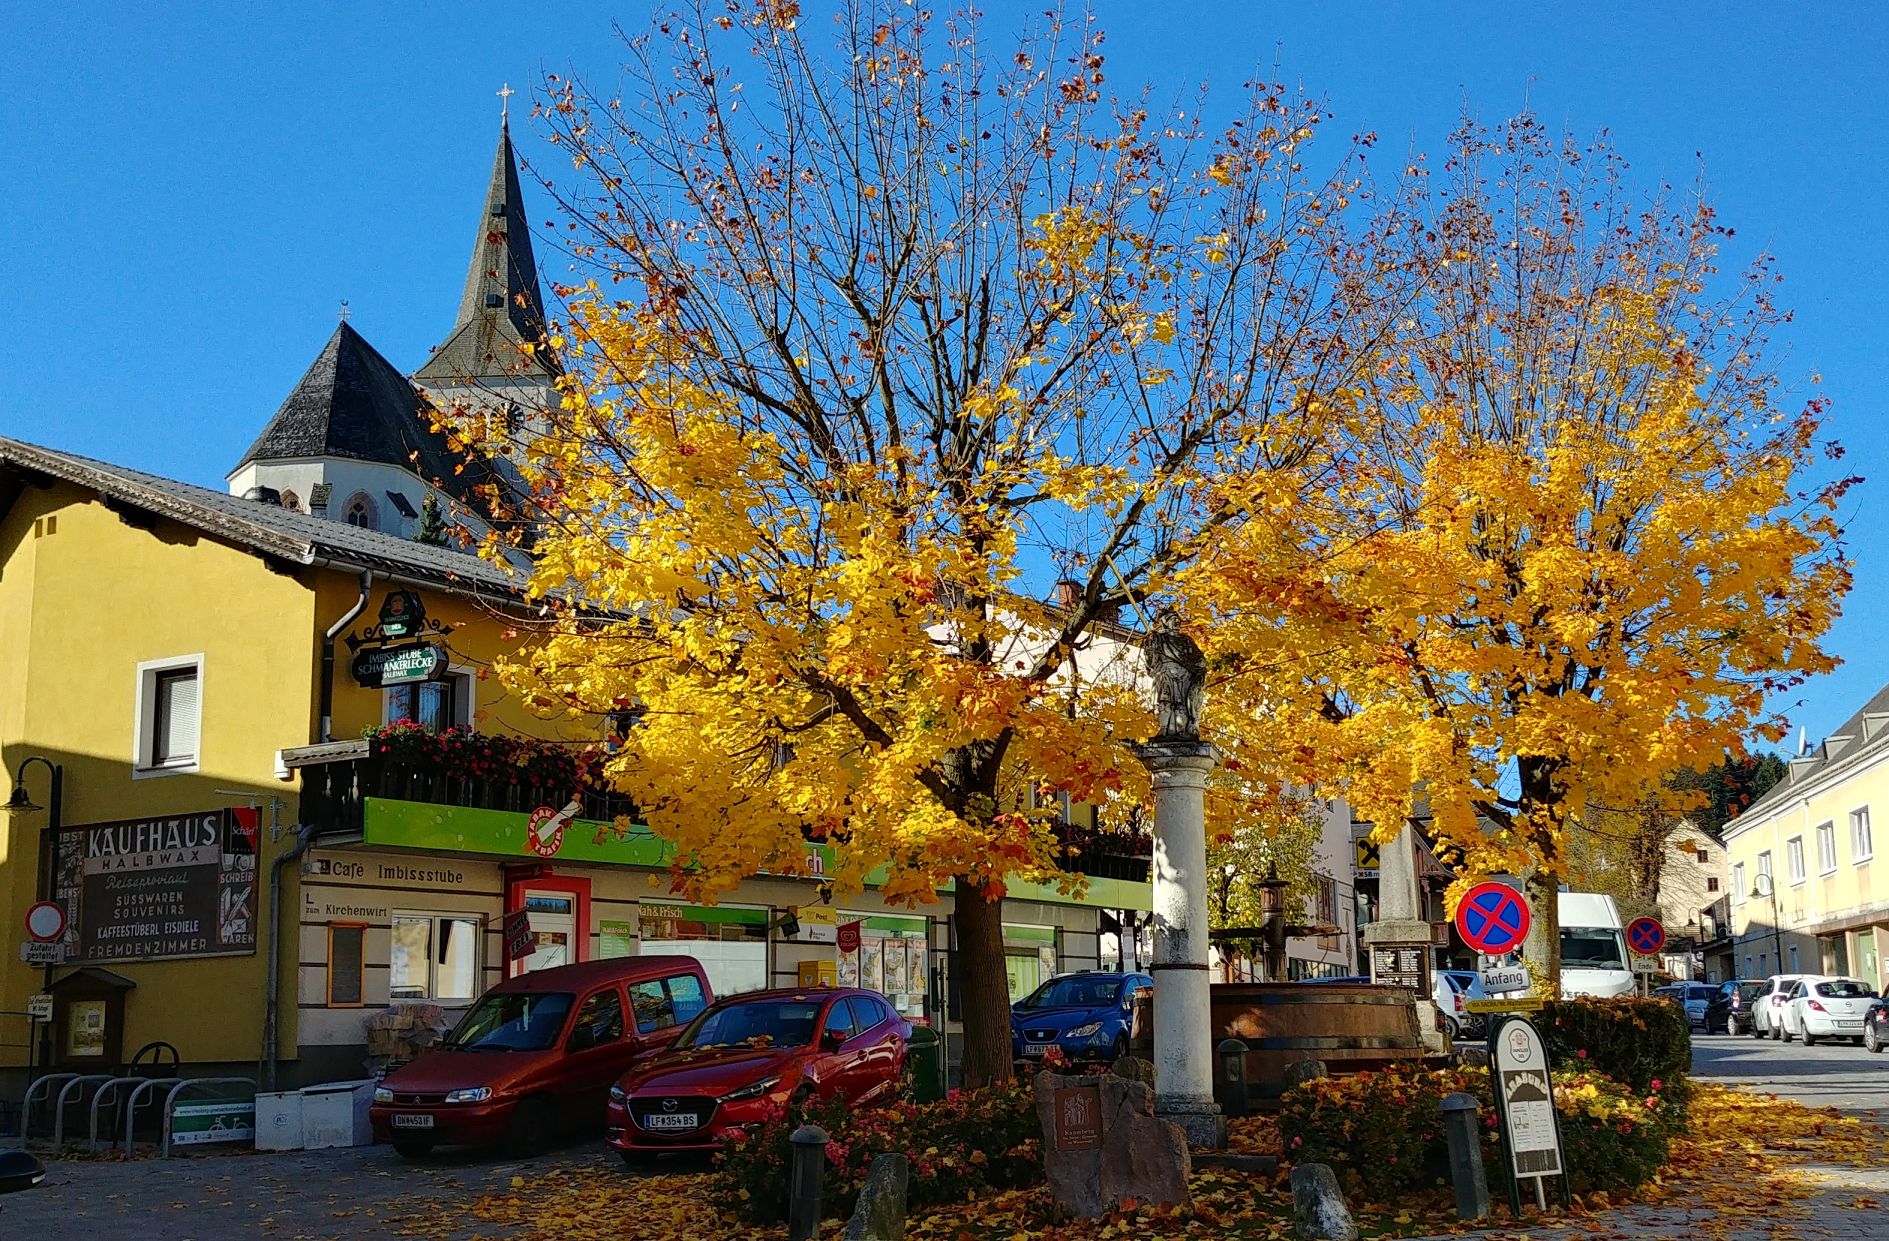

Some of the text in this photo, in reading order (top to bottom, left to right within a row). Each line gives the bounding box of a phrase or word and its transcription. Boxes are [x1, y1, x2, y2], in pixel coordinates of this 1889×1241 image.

[369, 648, 422, 663] IMBISS-STUBE
[358, 657, 433, 675] SCHMANKERLECKE
[59, 831, 84, 843] BST
[89, 815, 217, 858] KAUFHAUS
[534, 830, 562, 856] TRAFIK
[102, 850, 200, 870] HALBWAX
[220, 872, 254, 884] SCHREIB
[378, 864, 463, 884] Imbissstube
[114, 904, 185, 919] SOUVENIRS
[325, 904, 387, 917] Kirchenwirt
[815, 912, 828, 921] Post
[97, 919, 200, 939] KAFFEESTÜBERL EISDIELE
[221, 934, 255, 945] WAREN
[511, 935, 529, 954] FREI
[88, 938, 208, 959] FREMDENZIMMER
[1484, 972, 1524, 986] Anfang
